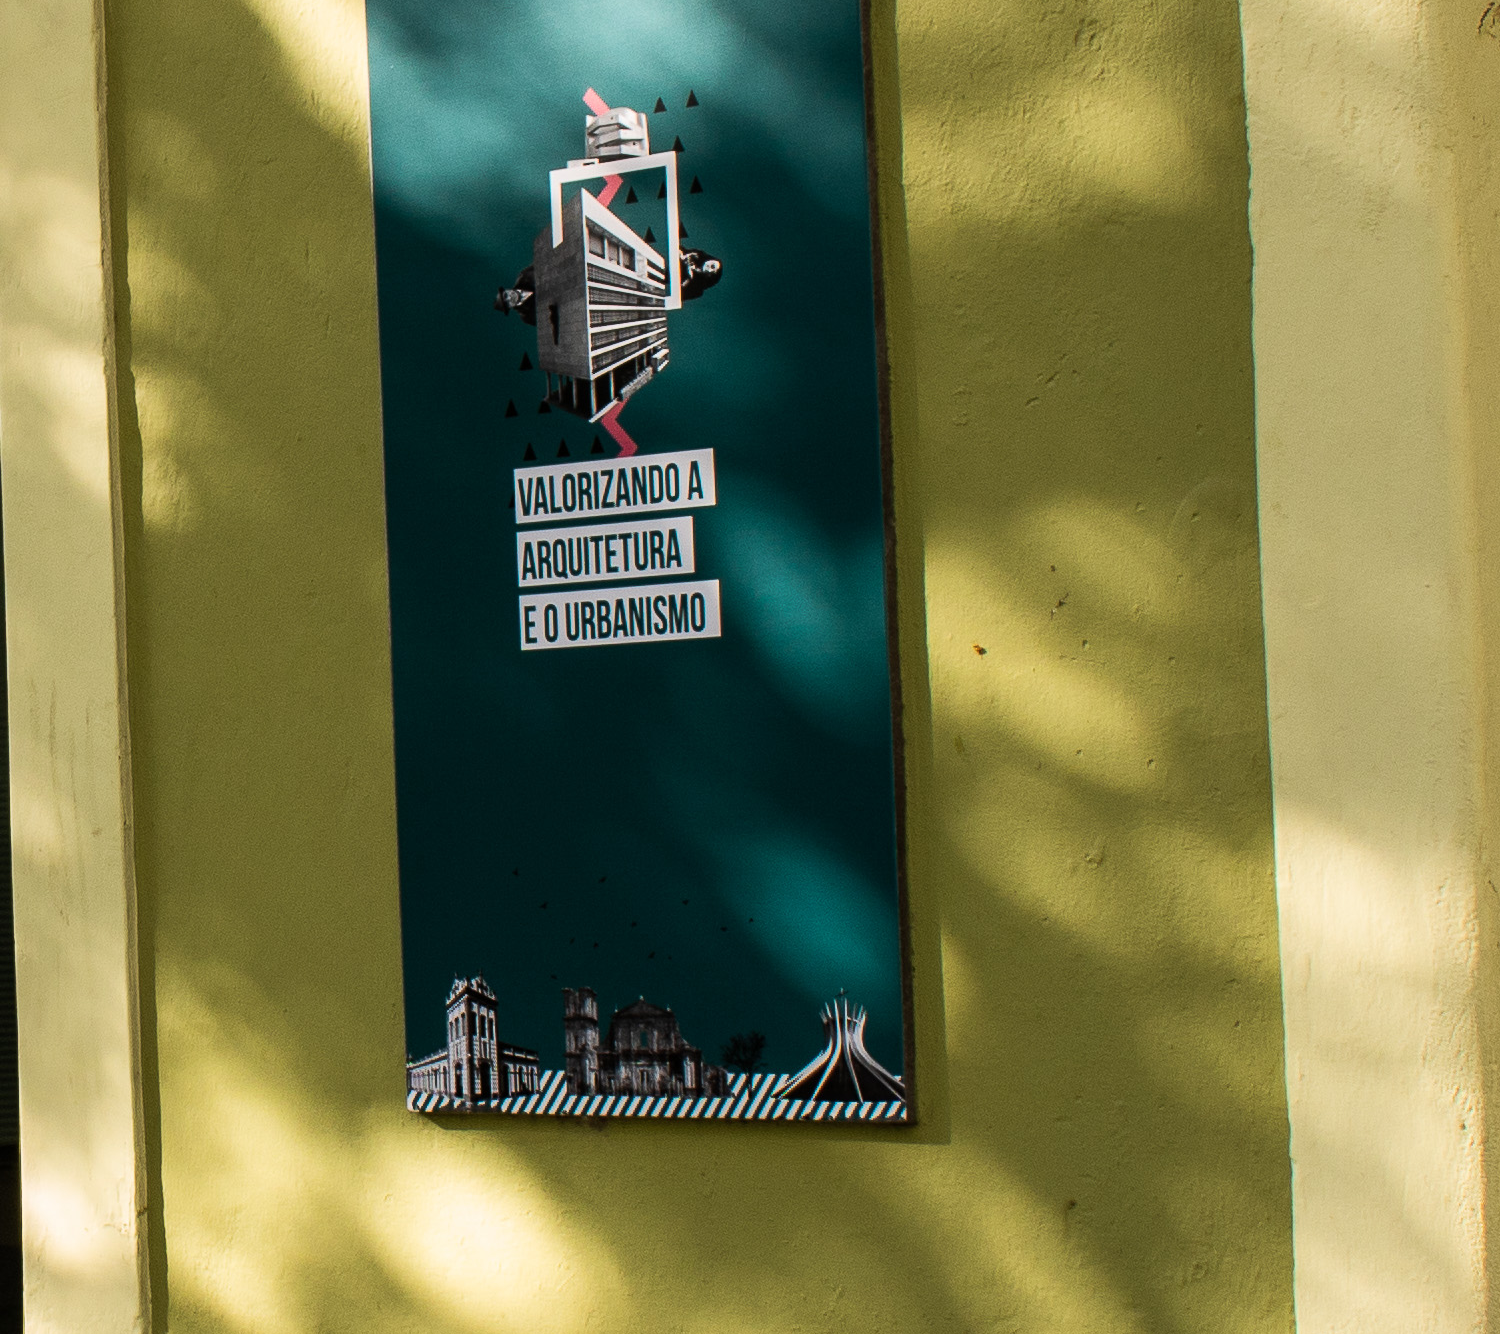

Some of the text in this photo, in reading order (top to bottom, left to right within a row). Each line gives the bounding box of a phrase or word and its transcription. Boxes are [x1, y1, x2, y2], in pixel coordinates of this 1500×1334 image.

[517, 460, 704, 516] VALORIZANDO A
[521, 528, 683, 581] ARQUITETURA
[523, 592, 706, 644] E O URBANISMO
